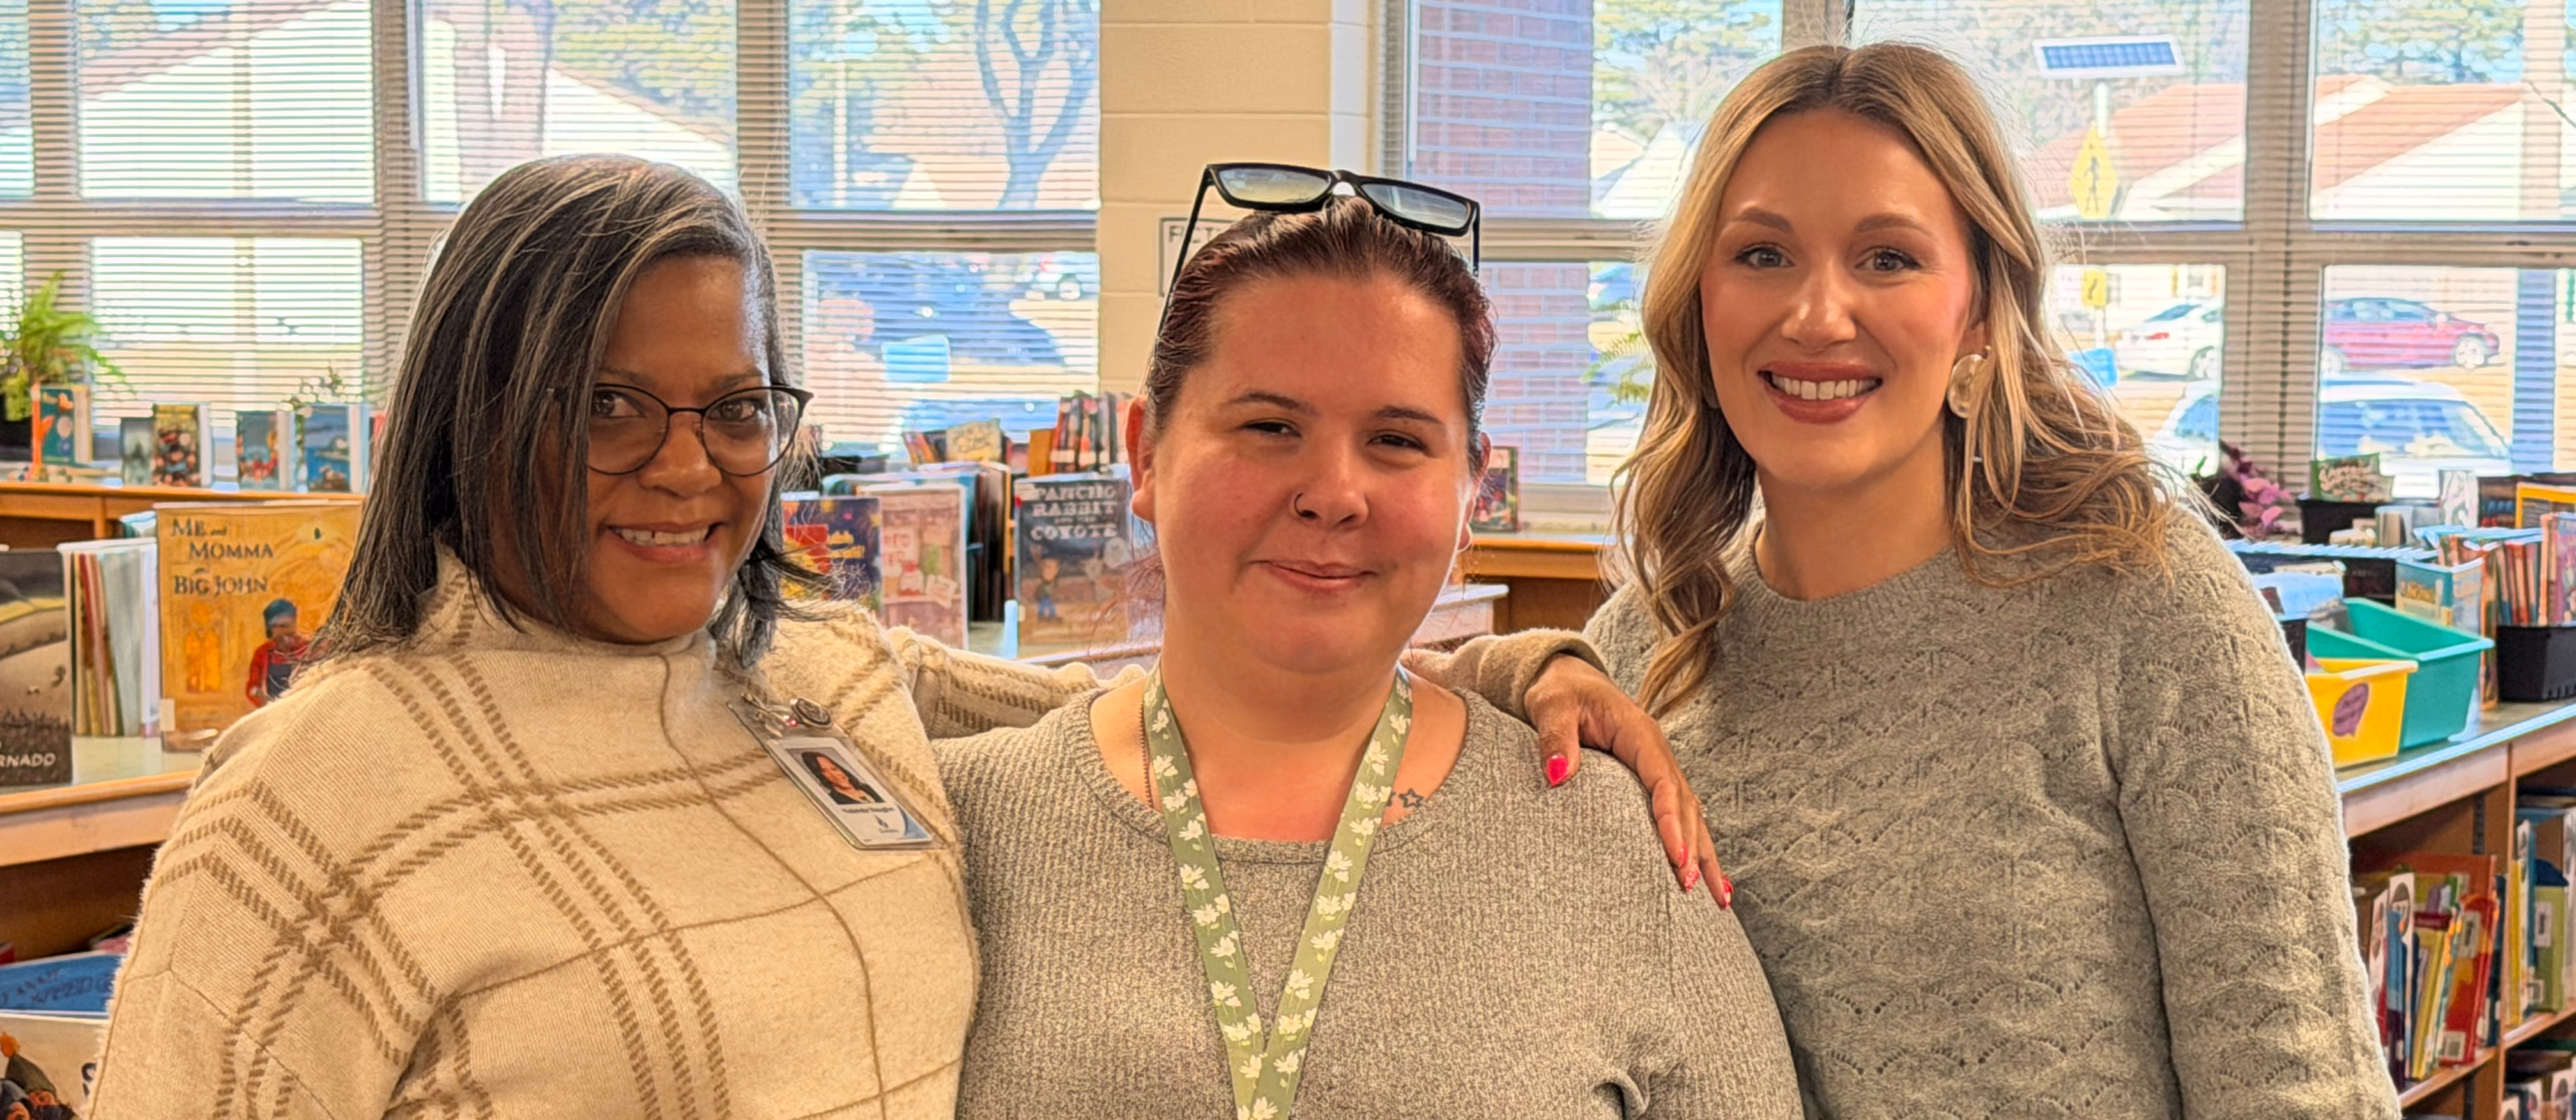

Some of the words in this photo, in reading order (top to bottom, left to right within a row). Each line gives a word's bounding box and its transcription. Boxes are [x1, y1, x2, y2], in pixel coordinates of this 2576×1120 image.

[1032, 501, 1117, 517] RABBIT
[171, 518, 206, 537] ME
[1030, 523, 1117, 541] COYOTE
[188, 541, 273, 560] MOMMA
[174, 575, 210, 595] BIG
[213, 574, 268, 598] JOHN
